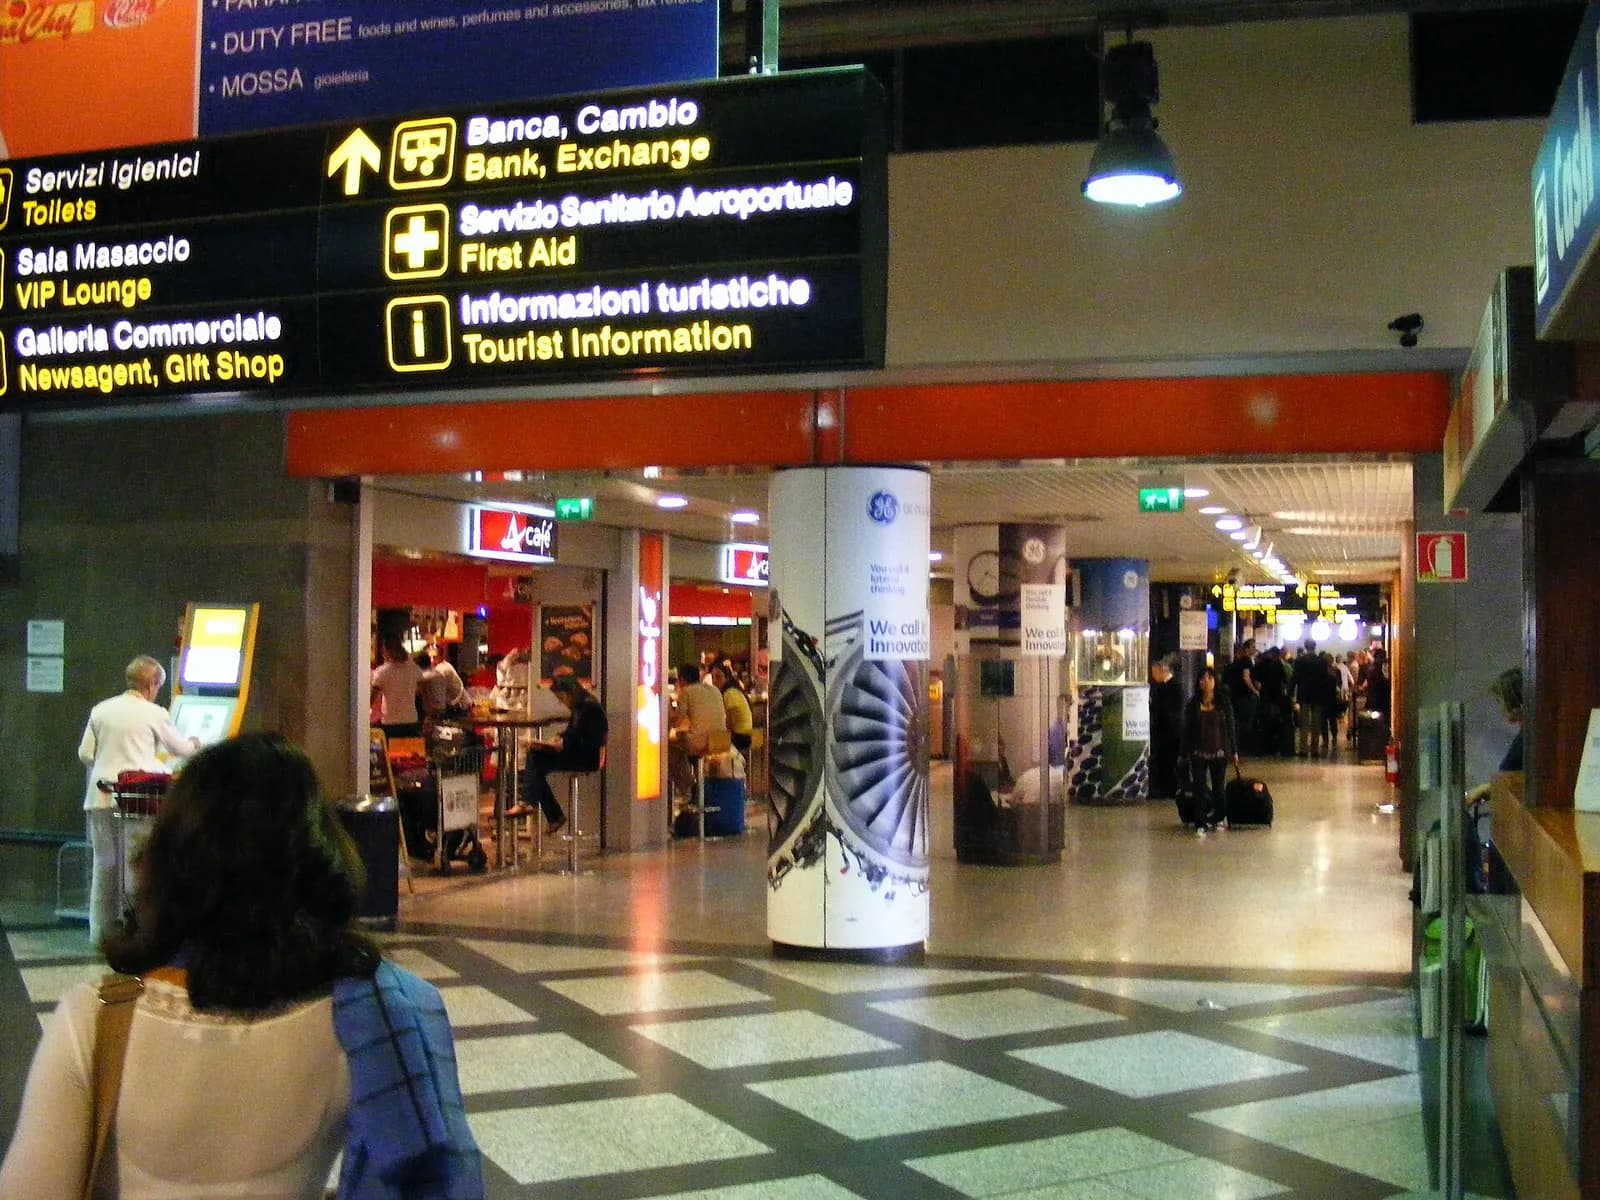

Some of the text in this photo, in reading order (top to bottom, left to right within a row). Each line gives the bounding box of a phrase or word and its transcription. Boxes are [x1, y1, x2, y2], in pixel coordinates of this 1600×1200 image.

[223, 27, 284, 56] DUTY
[291, 17, 353, 46] FREE
[358, 22, 391, 39] foods
[394, 18, 417, 34] and
[419, 15, 460, 32] wines,
[462, 9, 520, 29] perfumes
[524, 3, 549, 20] and
[222, 67, 304, 99] MOSSA
[466, 97, 699, 147] Banca, Cambio
[26, 150, 201, 193] Servizi Igienici
[463, 135, 710, 182] Bank, Exchange
[22, 196, 97, 227] Toilets
[459, 175, 853, 237] Servizio Sanitario Aeroportuale
[17, 235, 191, 276] Sala Masaccio
[460, 235, 577, 274] First Aid
[16, 277, 152, 310] VIP Lounge
[460, 273, 811, 327] Informazioni turistiche
[16, 312, 282, 357] Galleria Commerciale
[462, 319, 752, 365] Tourist Information
[19, 350, 285, 393] Newsagent, Gift Shop
[870, 619, 897, 635] We
[900, 618, 920, 635] call
[1025, 627, 1044, 639] We
